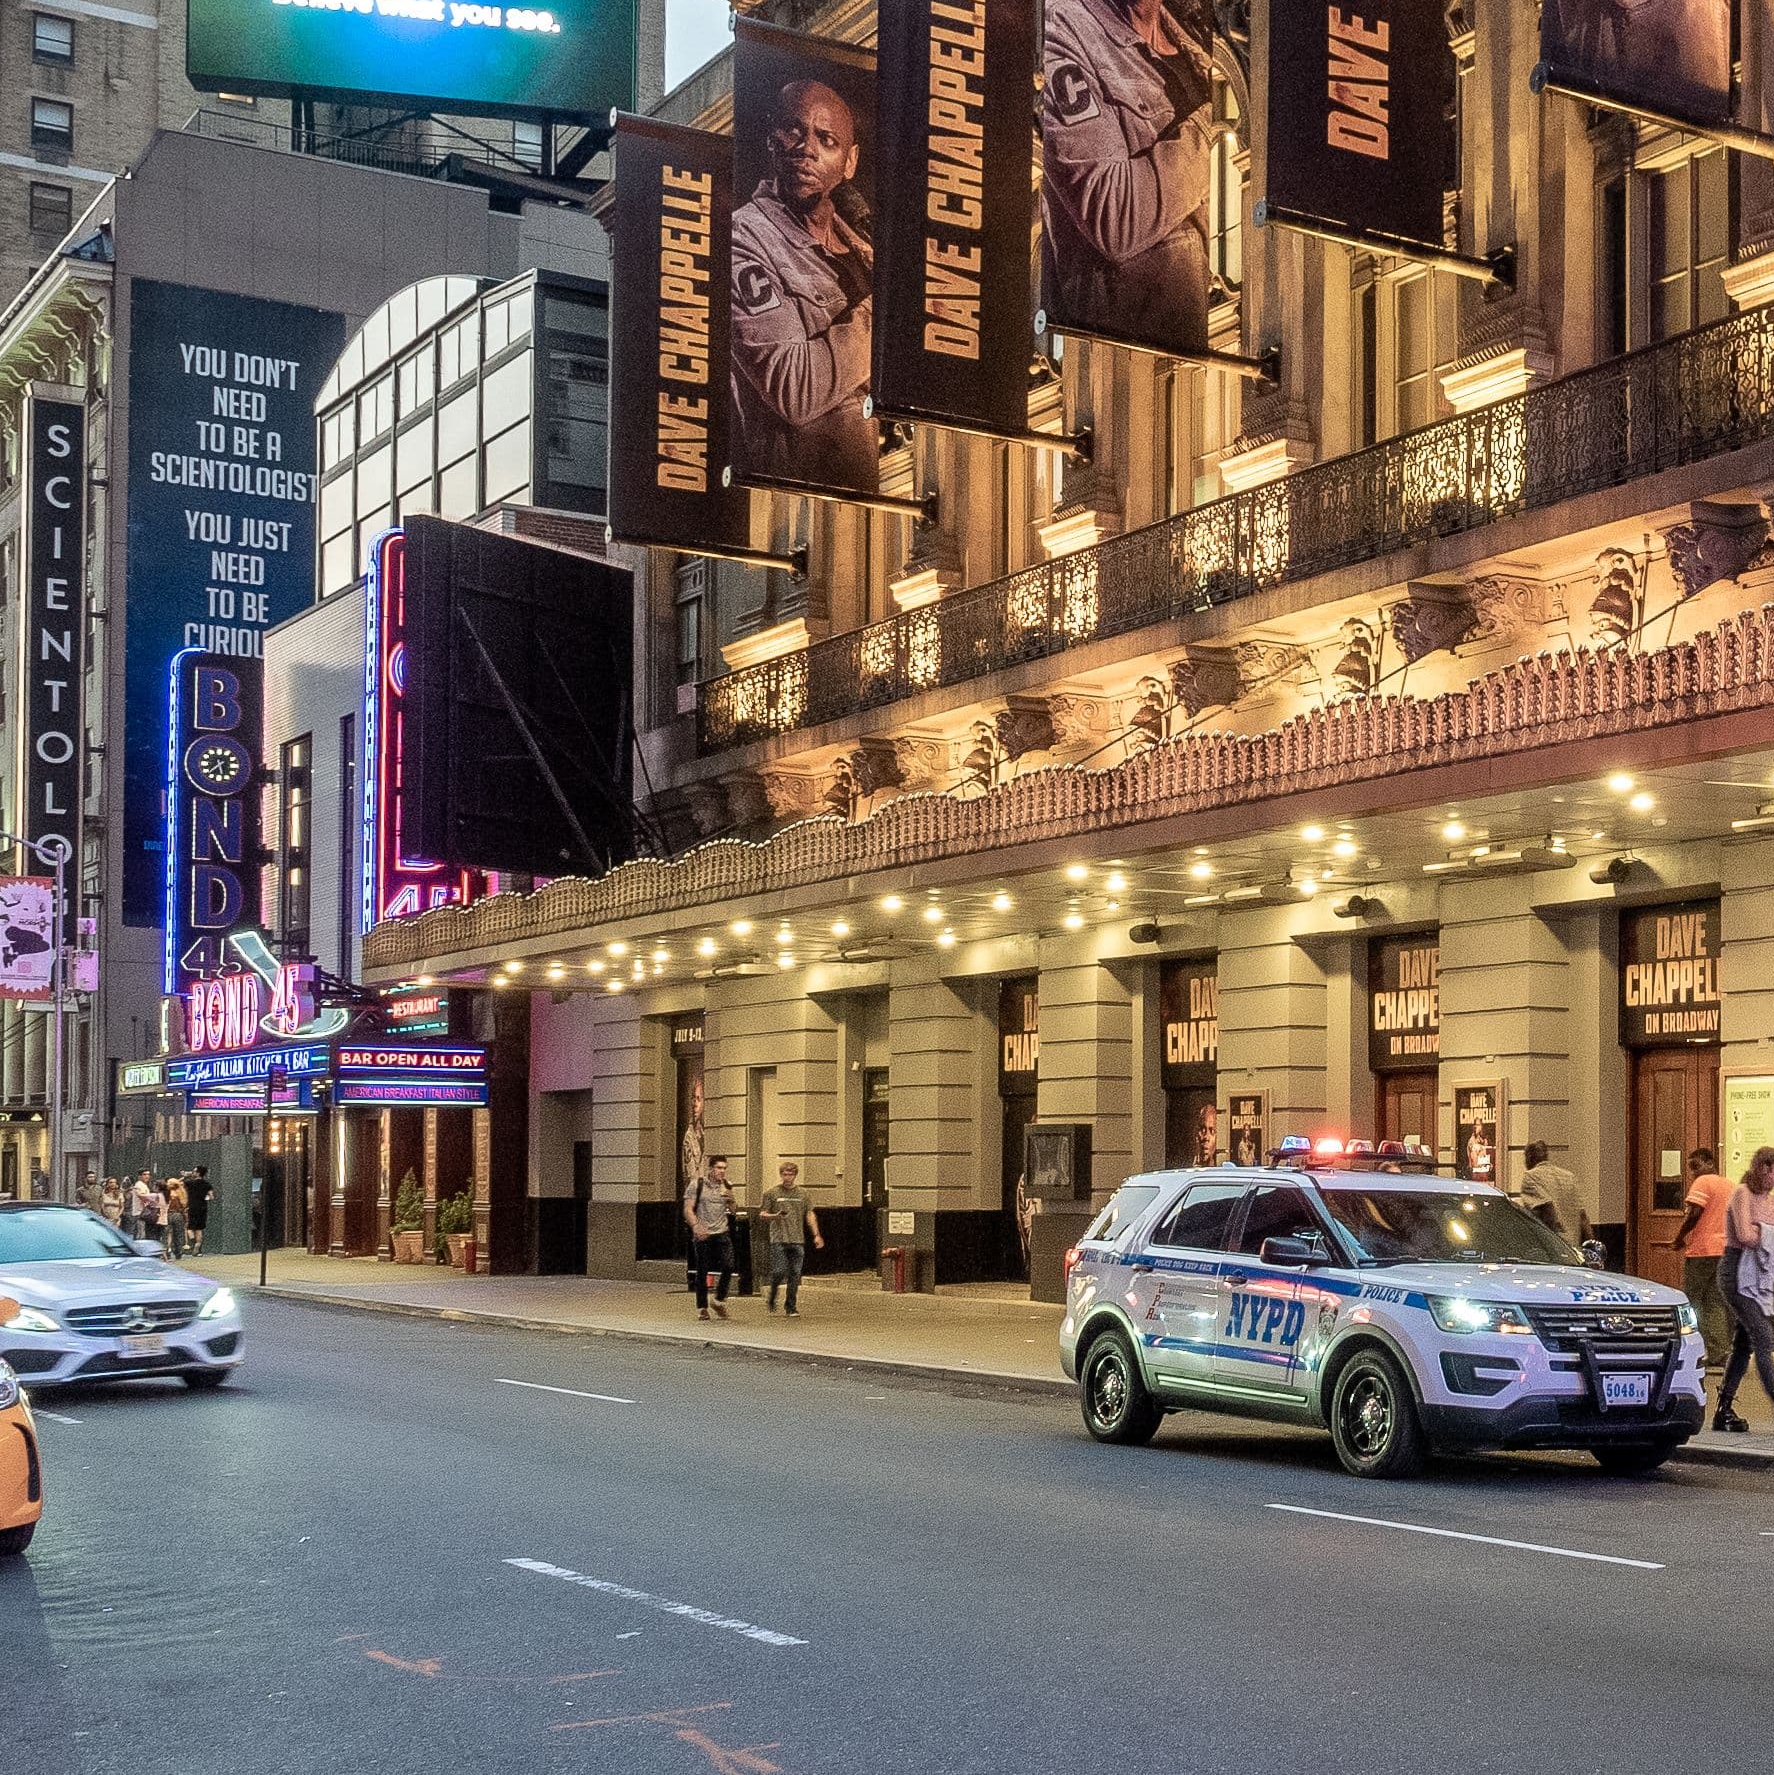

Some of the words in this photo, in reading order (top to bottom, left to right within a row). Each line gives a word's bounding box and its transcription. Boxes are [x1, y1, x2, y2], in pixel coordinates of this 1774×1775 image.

[450, 3, 502, 27] you
[505, 8, 561, 33] see.
[1327, 10, 1390, 161] DAVE
[658, 165, 712, 383] CHAPPELLE
[923, 240, 981, 360] DAVE
[179, 343, 227, 379] YOU
[234, 352, 300, 391] DON'T
[213, 386, 266, 423] NEED
[196, 420, 226, 453] TO
[233, 426, 260, 459] BE
[266, 431, 281, 461] A
[657, 397, 708, 493] DAVE
[151, 452, 317, 503] SCIENTOLOGIST
[184, 509, 231, 544] YOU
[238, 517, 292, 552] JUST
[211, 551, 265, 586] NEED
[205, 587, 235, 619] TO
[242, 592, 270, 623] BE
[35, 424, 76, 944] SCIENTOLO
[184, 666, 251, 927] BOND
[1656, 912, 1707, 959] DAVE
[1400, 947, 1439, 989] DAVE
[191, 974, 259, 1052] BOND
[271, 963, 300, 1034] 45
[1374, 989, 1439, 1030] CHAPPE
[1645, 1013, 1660, 1034] ON
[1662, 1010, 1719, 1034] BROADWAY
[213, 1059, 244, 1078] ITALIAN
[293, 1051, 310, 1070] BAR
[340, 1053, 372, 1065] BAR
[376, 1053, 417, 1066] OPEN
[421, 1055, 449, 1067] ALL
[452, 1055, 481, 1067] DAY
[1390, 1036, 1402, 1055] ON
[195, 1099, 229, 1108] AMERICAN
[344, 1087, 383, 1099] AMERICAN
[384, 1088, 428, 1099] BREAKFAST
[1240, 1100, 1255, 1115] DAVE
[1469, 1092, 1487, 1108] DAVE
[1365, 1284, 1403, 1304] POLICE
[1225, 1292, 1306, 1347] NYPD
[1606, 1383, 1635, 1398] 5048
